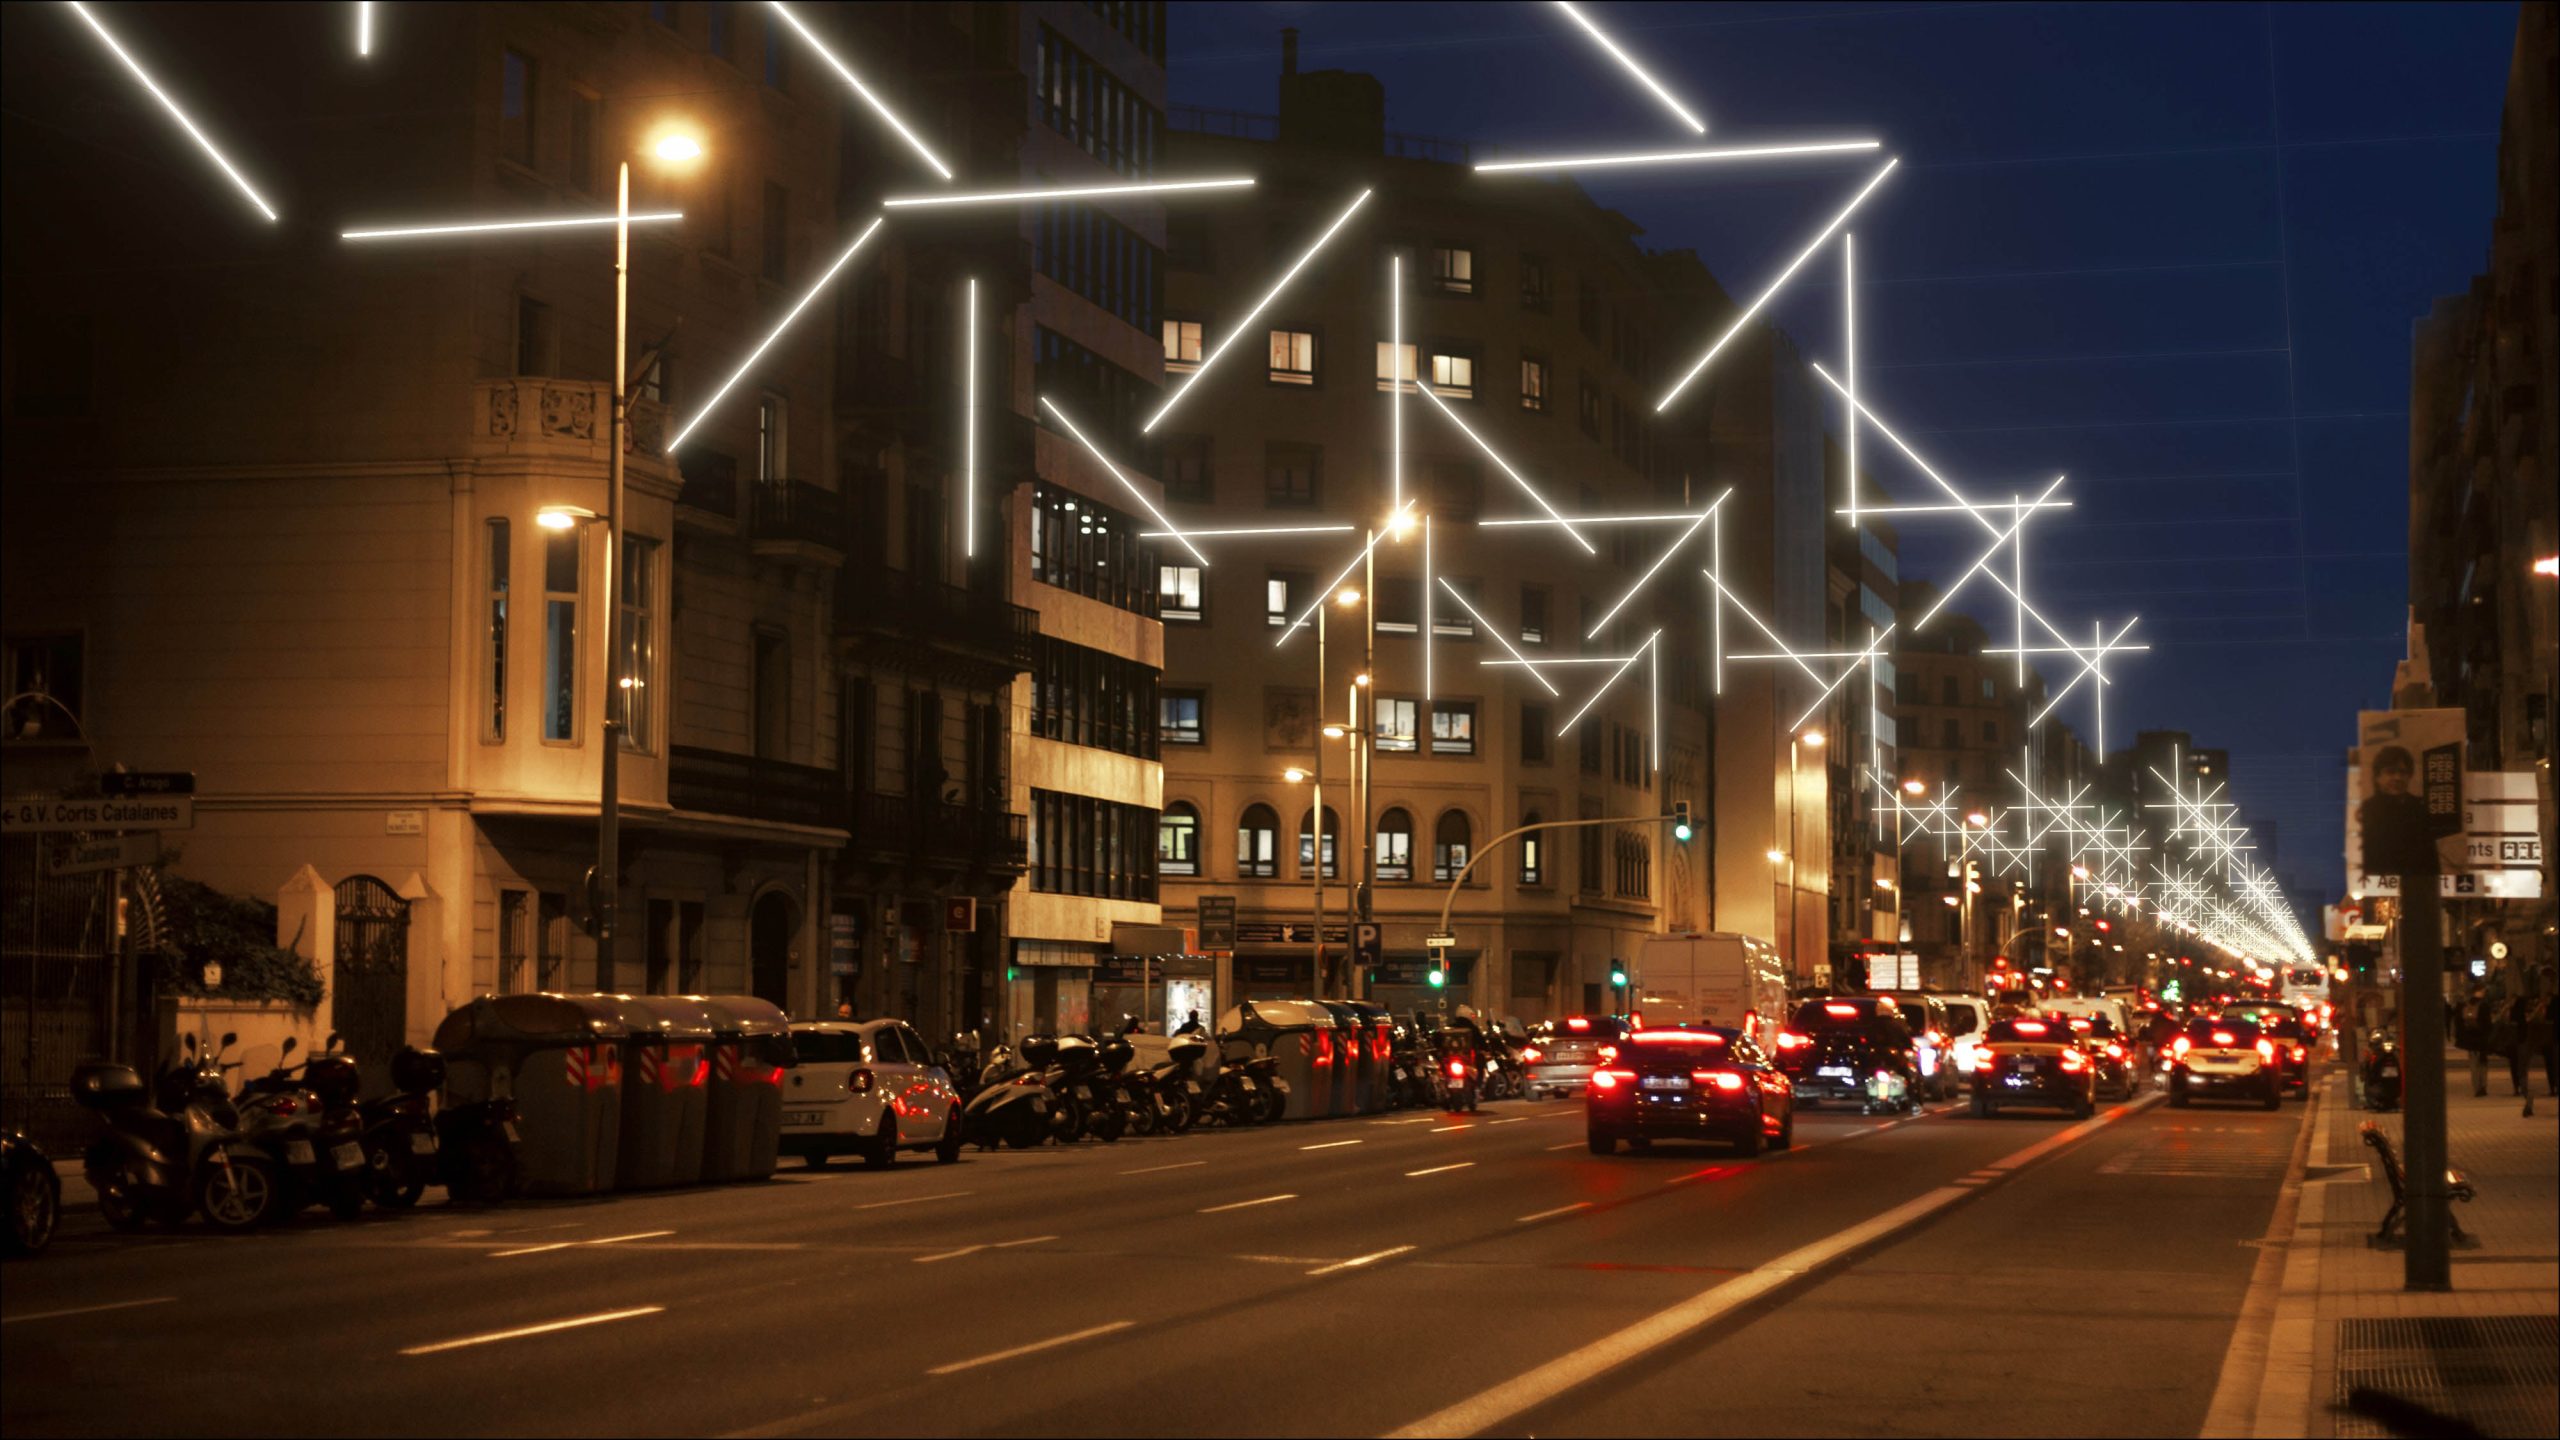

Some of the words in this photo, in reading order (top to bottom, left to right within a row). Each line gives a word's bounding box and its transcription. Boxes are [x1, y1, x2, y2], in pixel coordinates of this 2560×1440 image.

[2428, 761, 2455, 771] PER
[2428, 771, 2455, 783] FER
[2429, 792, 2455, 803] PER
[20, 804, 50, 823] G.V.
[55, 804, 97, 822] Corts
[101, 803, 178, 821] Catalanes
[2429, 803, 2456, 814] SER
